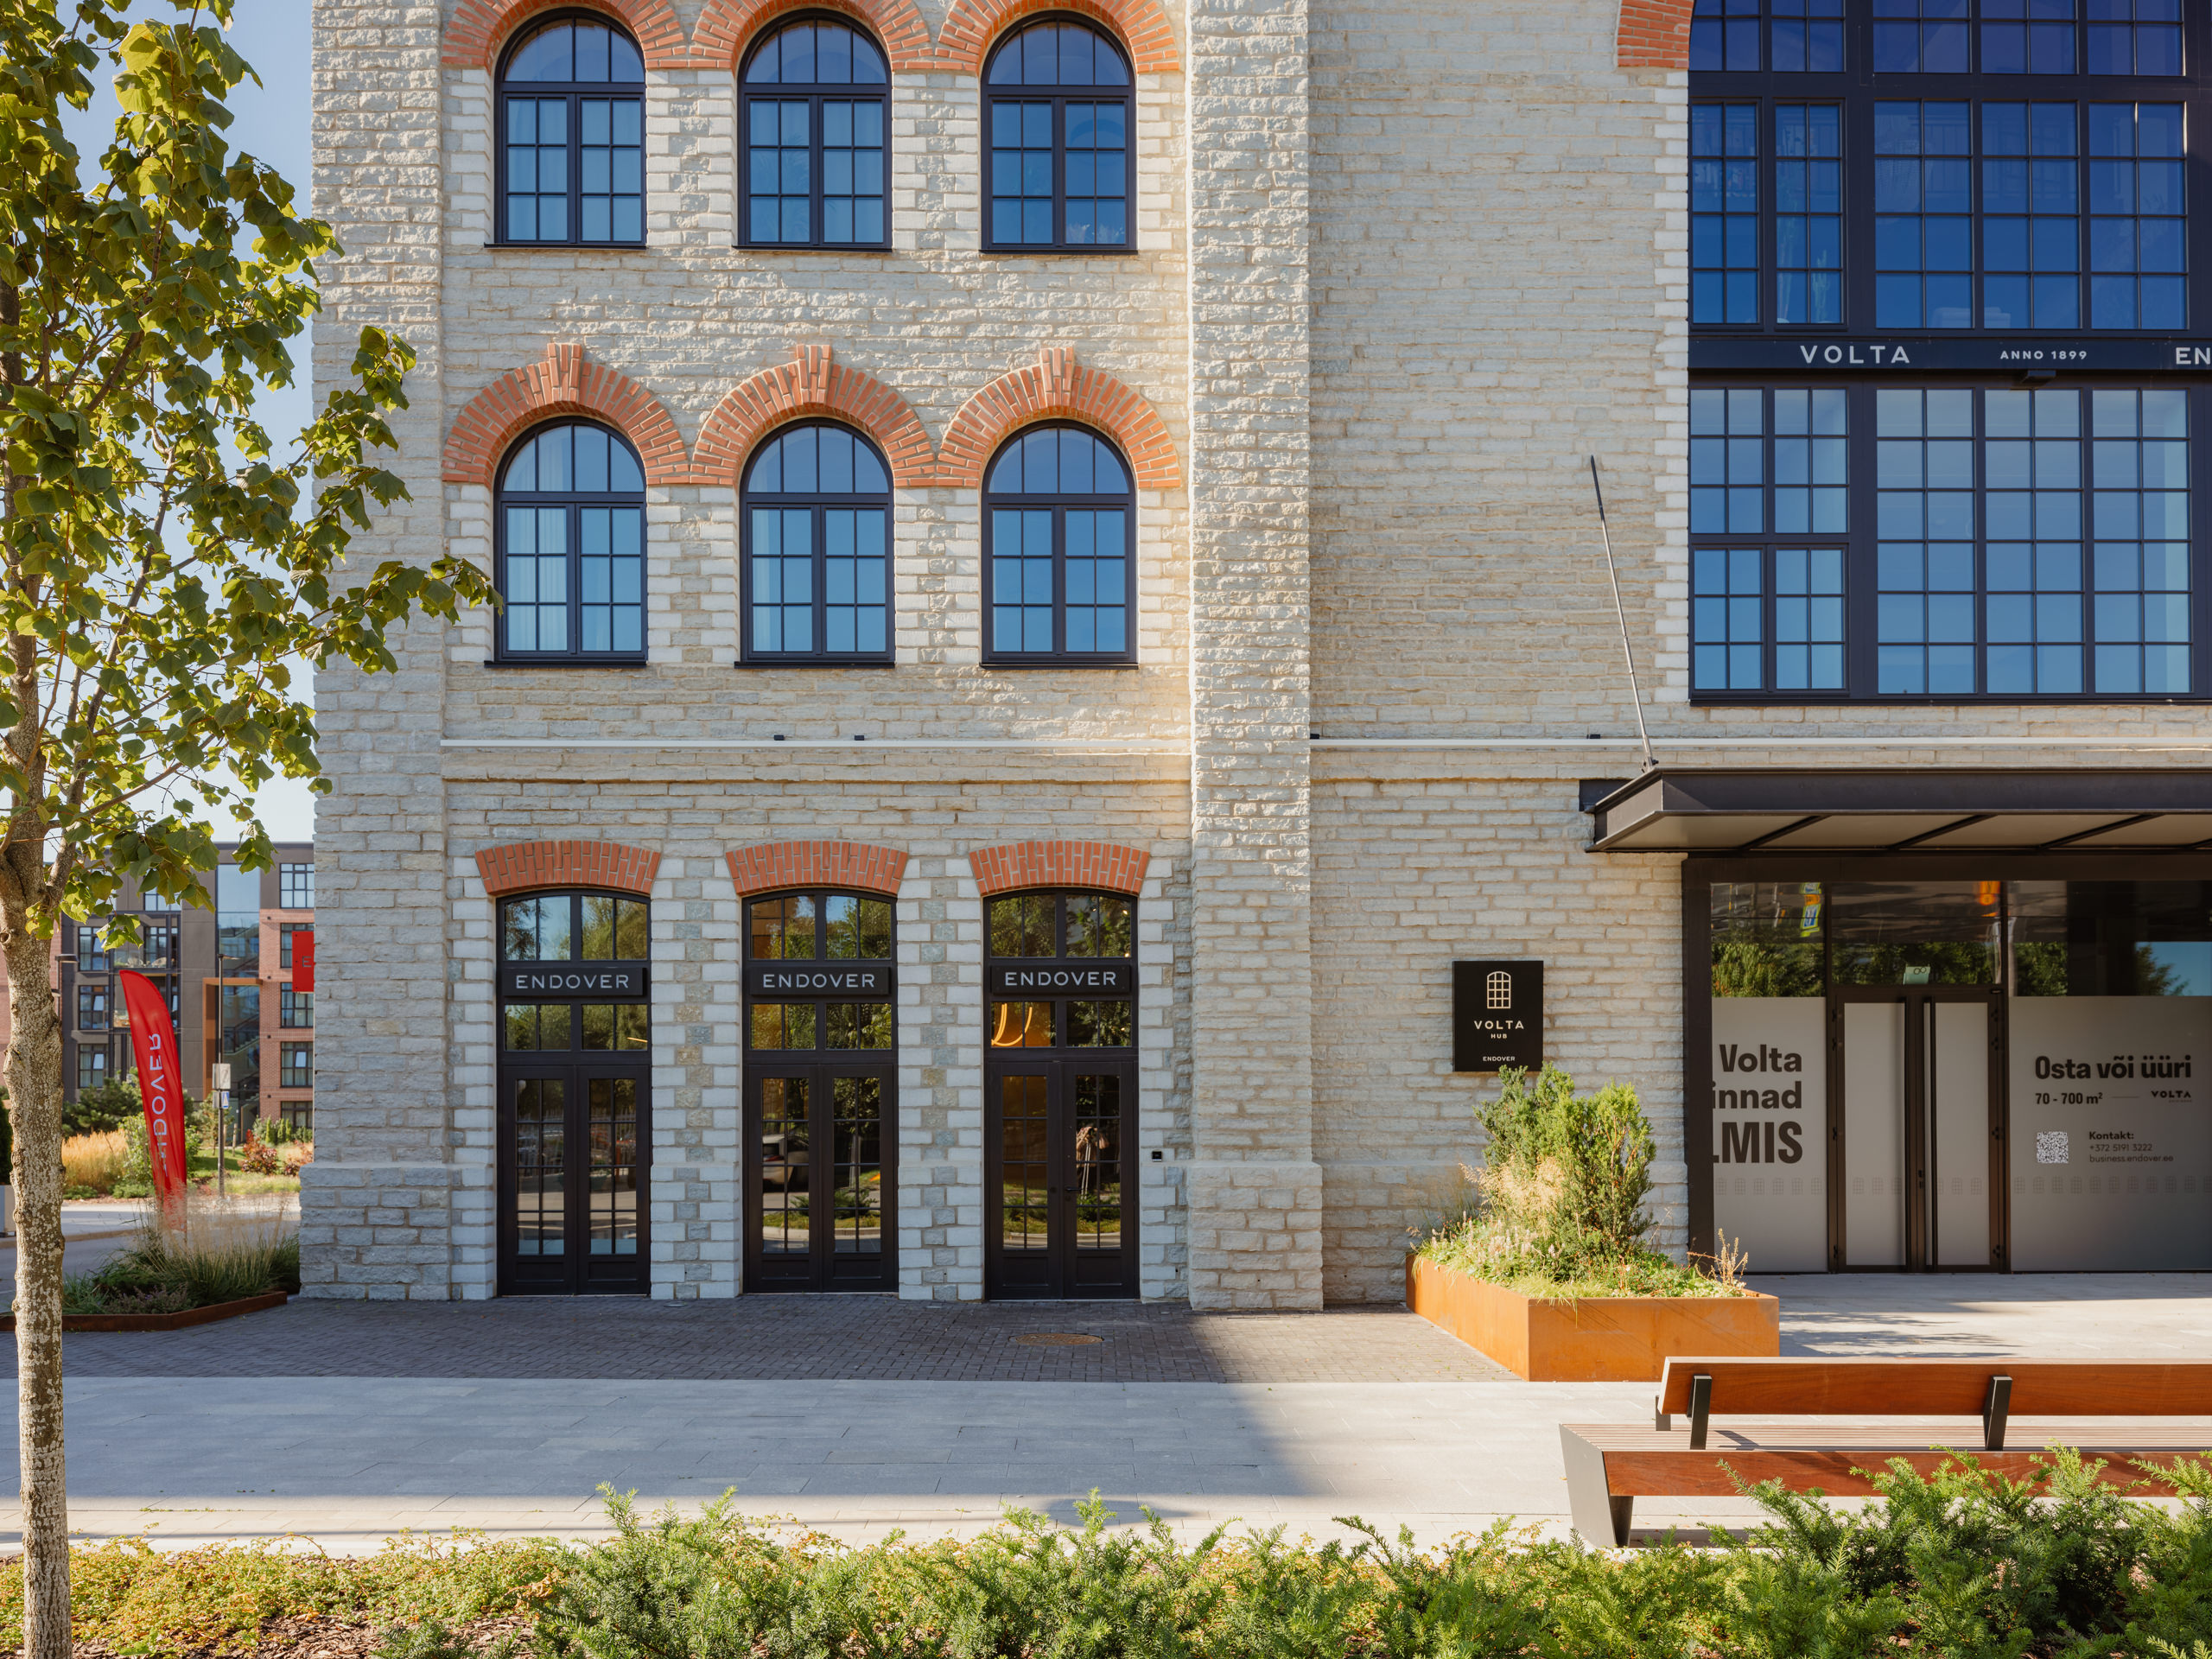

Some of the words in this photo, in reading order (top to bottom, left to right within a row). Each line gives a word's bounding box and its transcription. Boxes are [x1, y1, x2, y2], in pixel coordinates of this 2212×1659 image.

[1800, 345, 1910, 364] VOLTA
[1999, 350, 2044, 359] ANNO
[2050, 350, 2088, 359] 1899
[2176, 346, 2211, 365] EN
[516, 974, 629, 989] ENDOVER
[763, 973, 875, 988] ENDOVER
[1005, 971, 1116, 986] ENDOVER
[1473, 1020, 1524, 1029] VOLTA
[1719, 1044, 1802, 1072] Volta
[2035, 1056, 2091, 1079] Osta
[2096, 1055, 2134, 1079] või
[2140, 1055, 2191, 1078] üüri
[2035, 1093, 2050, 1104] 70
[2061, 1093, 2083, 1104] 700
[1713, 1122, 1802, 1164] MIS
[2088, 1131, 2134, 1140] Kontakt:
[2133, 1143, 2152, 1152] 3222
[2089, 1154, 2174, 1162] business.endover.ee
